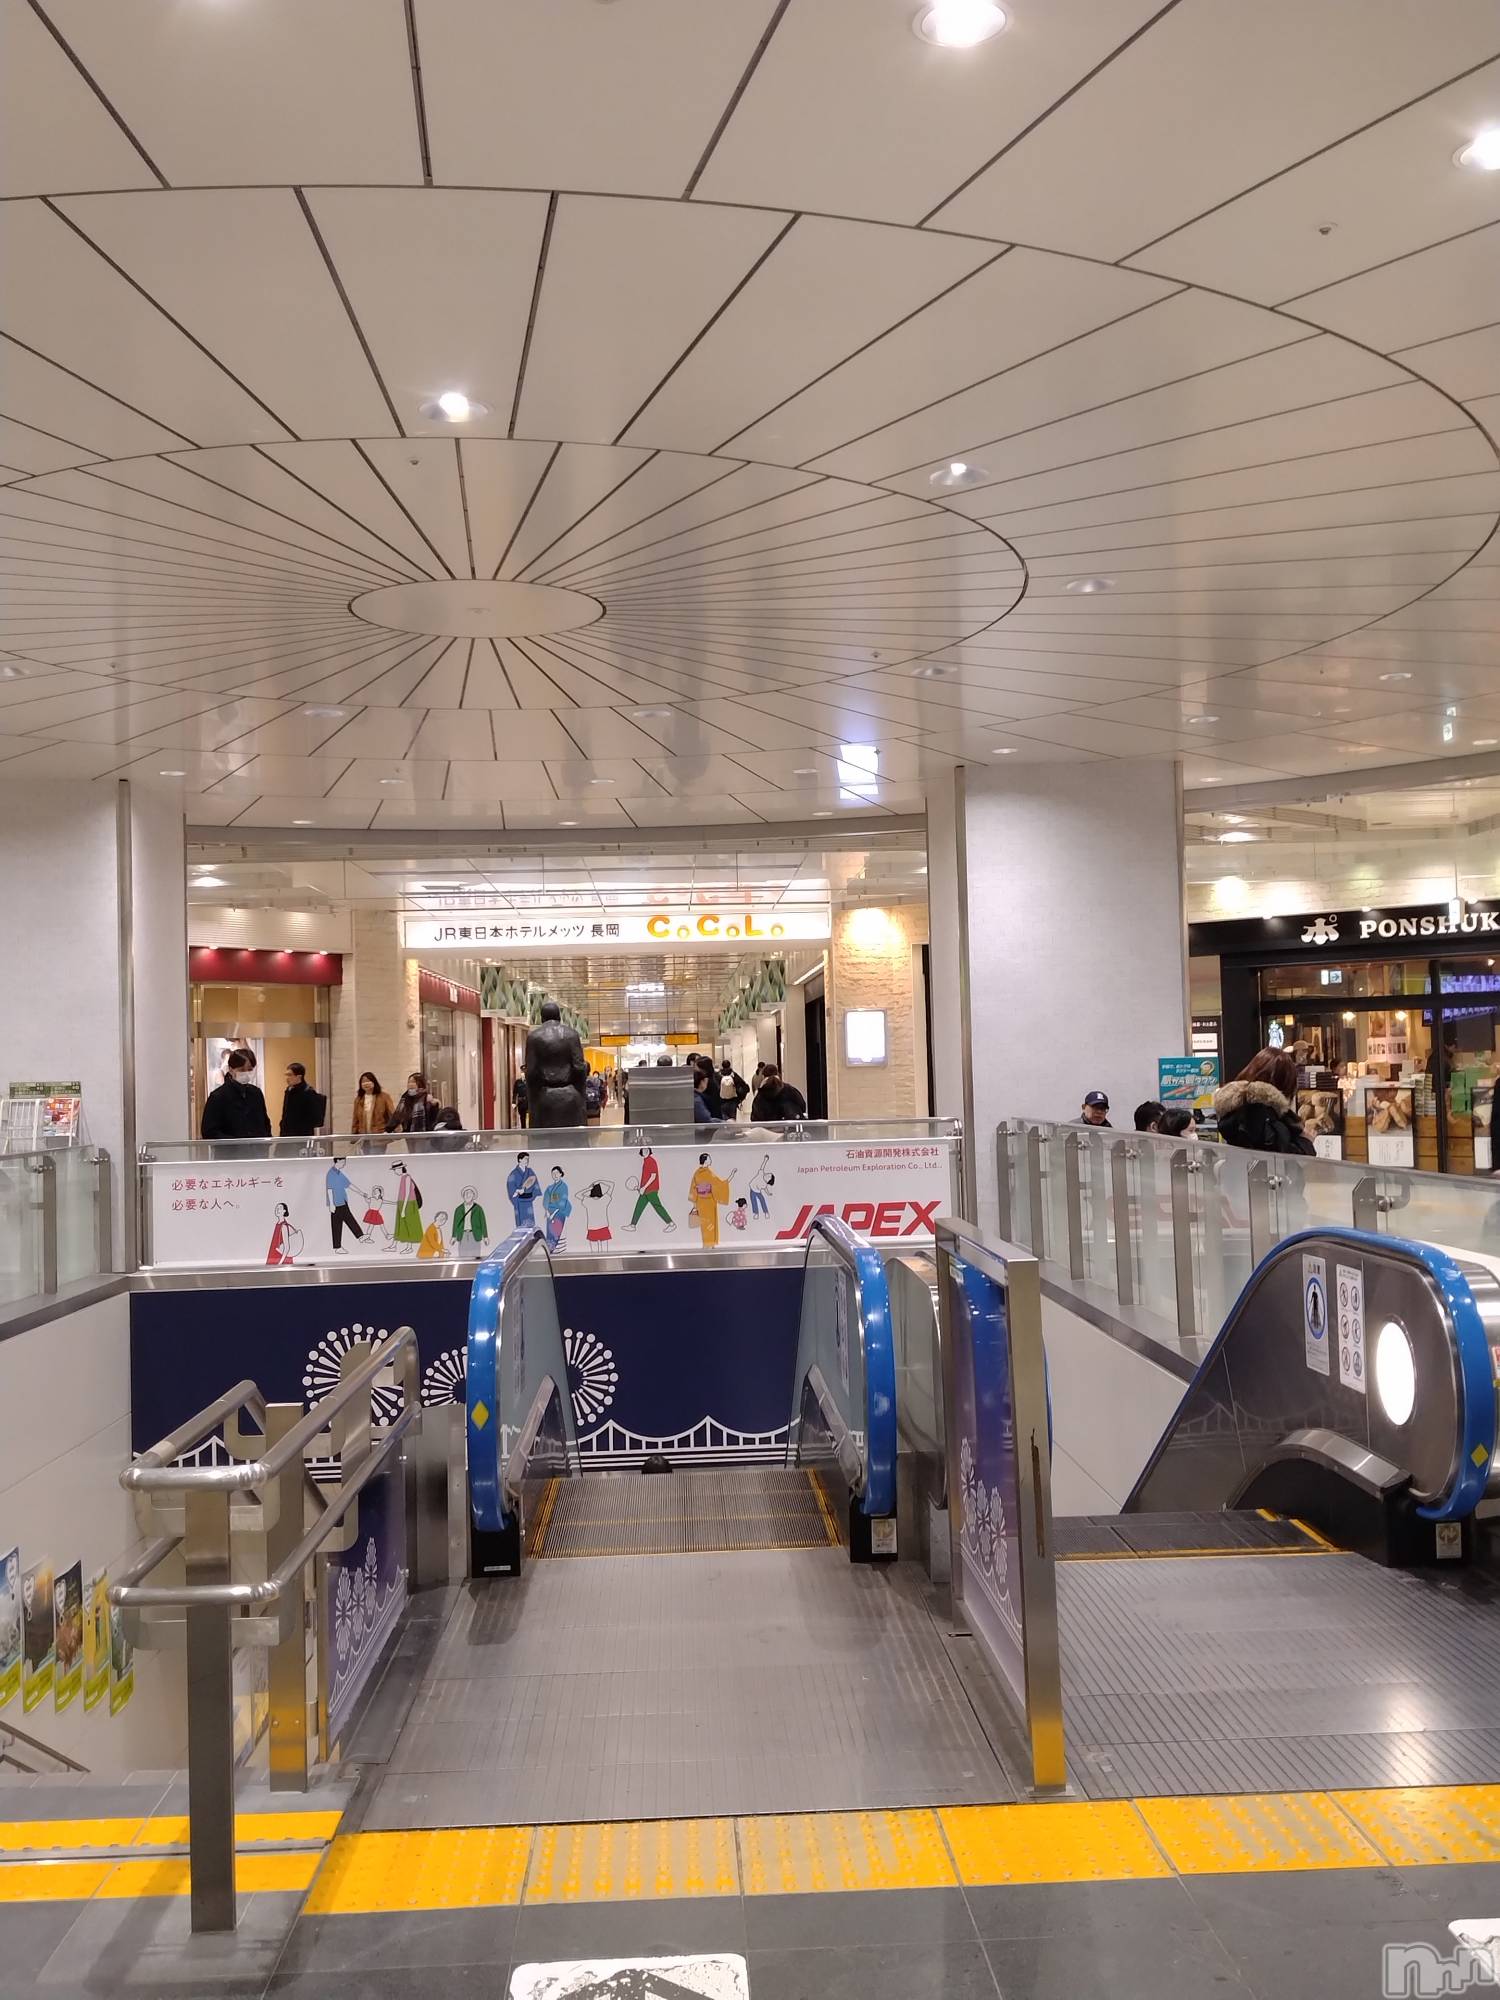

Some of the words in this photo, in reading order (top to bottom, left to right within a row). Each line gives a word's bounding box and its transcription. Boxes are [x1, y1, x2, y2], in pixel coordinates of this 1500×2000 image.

[434, 925, 585, 942] JR東日本ホテルメッツ
[591, 924, 620, 937] 長岡
[846, 1147, 940, 1159] 石油資源開発株式会社
[797, 1164, 819, 1174] Japan
[820, 1164, 861, 1173] Petroleum
[862, 1162, 906, 1173] Exploration
[171, 1176, 284, 1191] 必要なエネルギーを
